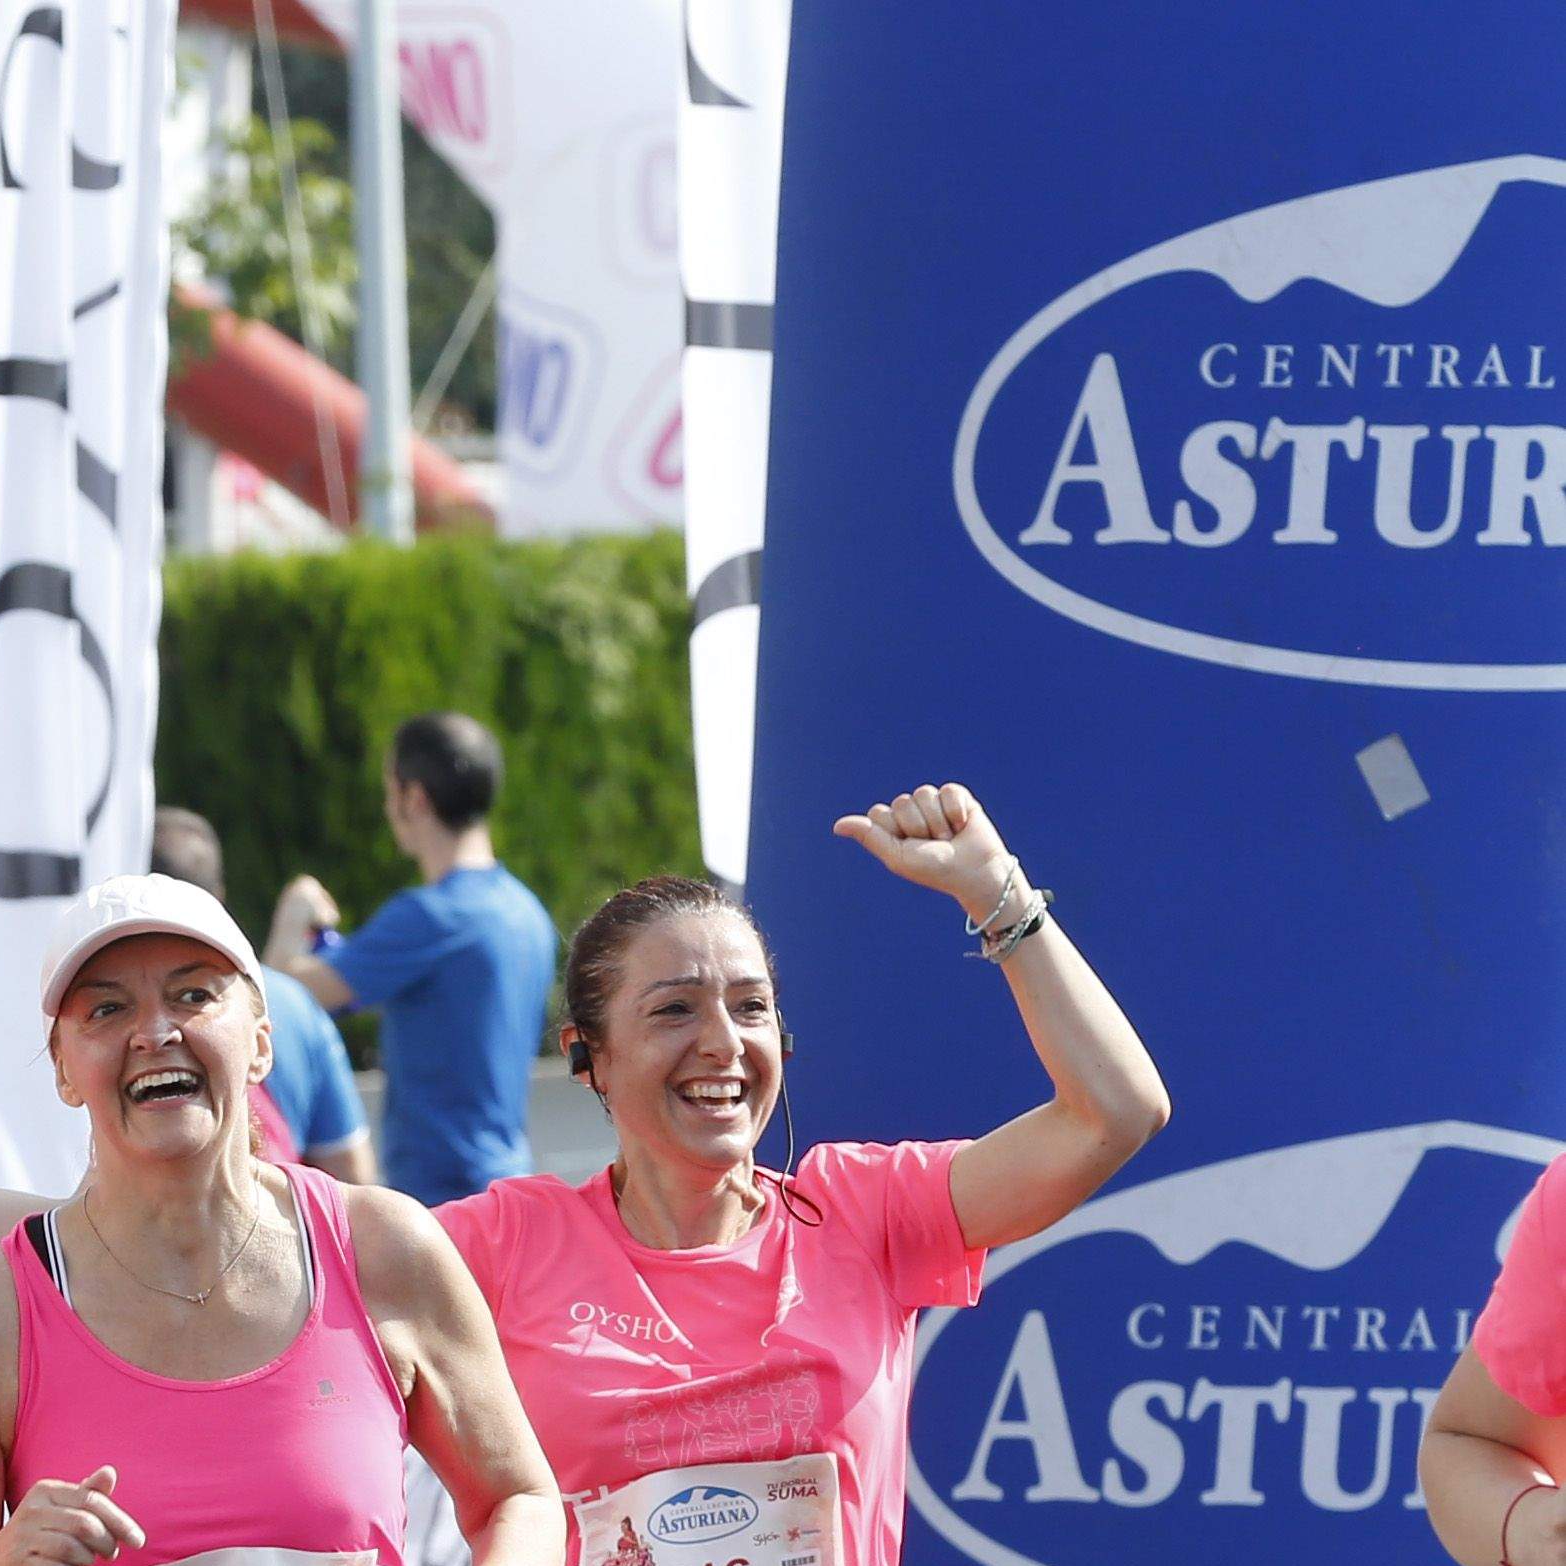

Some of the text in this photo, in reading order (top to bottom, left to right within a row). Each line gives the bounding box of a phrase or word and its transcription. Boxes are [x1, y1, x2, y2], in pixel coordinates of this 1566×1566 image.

[1199, 343, 1555, 389] CENTRAL
[570, 1301, 678, 1344] OYSHO
[768, 1486, 818, 1501] SUMA
[658, 1507, 750, 1536] ASTURIANA
